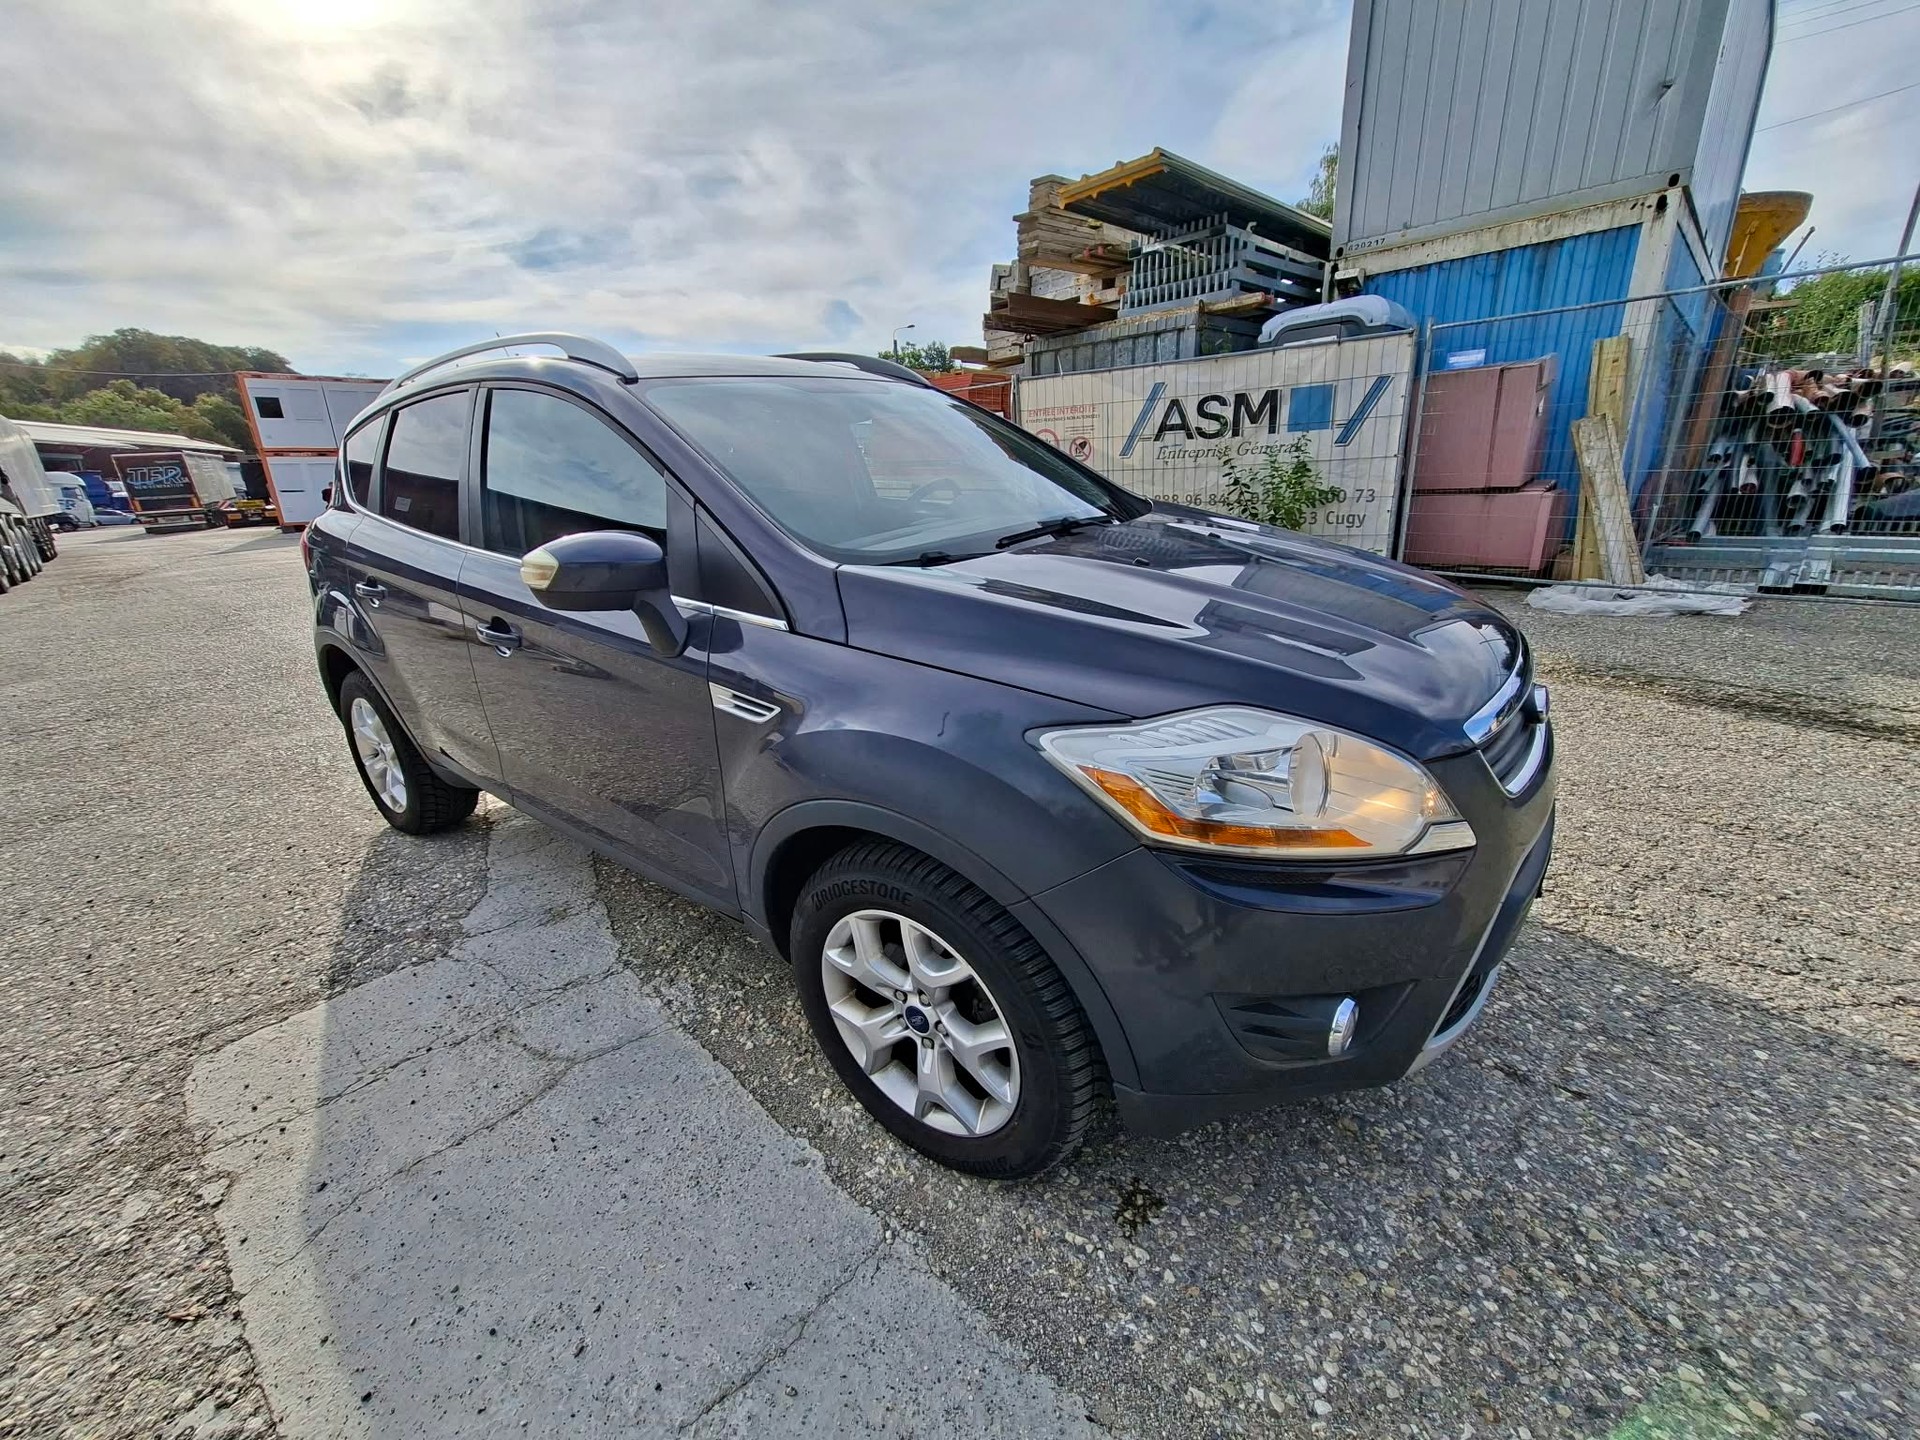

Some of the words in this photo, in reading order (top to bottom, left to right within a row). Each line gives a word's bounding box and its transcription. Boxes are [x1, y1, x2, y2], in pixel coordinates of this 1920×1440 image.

[1153, 389, 1281, 442] ASM
[1156, 445, 1231, 463] Entreprise
[1185, 494, 1202, 506] 96
[1355, 489, 1376, 503] 73
[1326, 510, 1366, 528] Cugy
